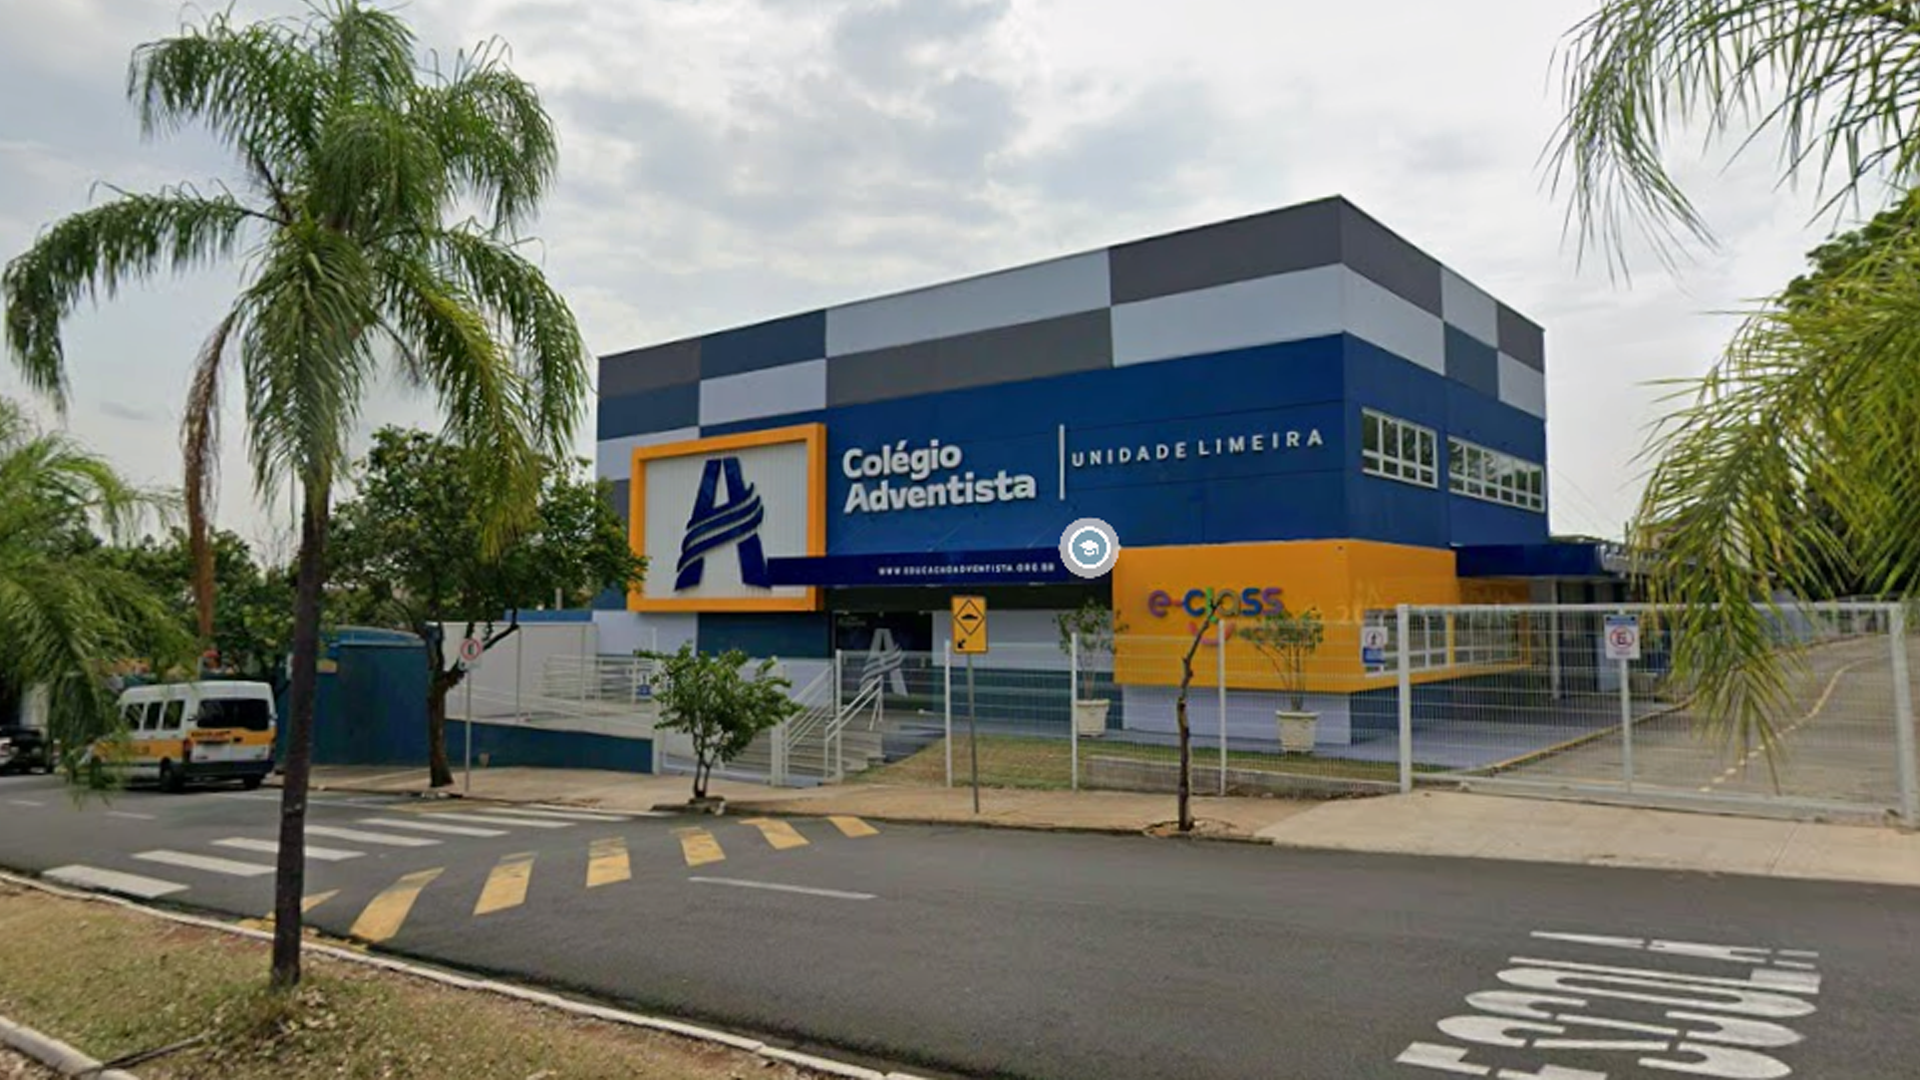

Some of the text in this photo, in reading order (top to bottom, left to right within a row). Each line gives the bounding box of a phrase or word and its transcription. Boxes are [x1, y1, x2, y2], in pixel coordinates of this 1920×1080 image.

[842, 439, 962, 480] Colégio
[1071, 429, 1323, 467] UNIDADE LIMEIRA
[844, 470, 1036, 514] Adventista
